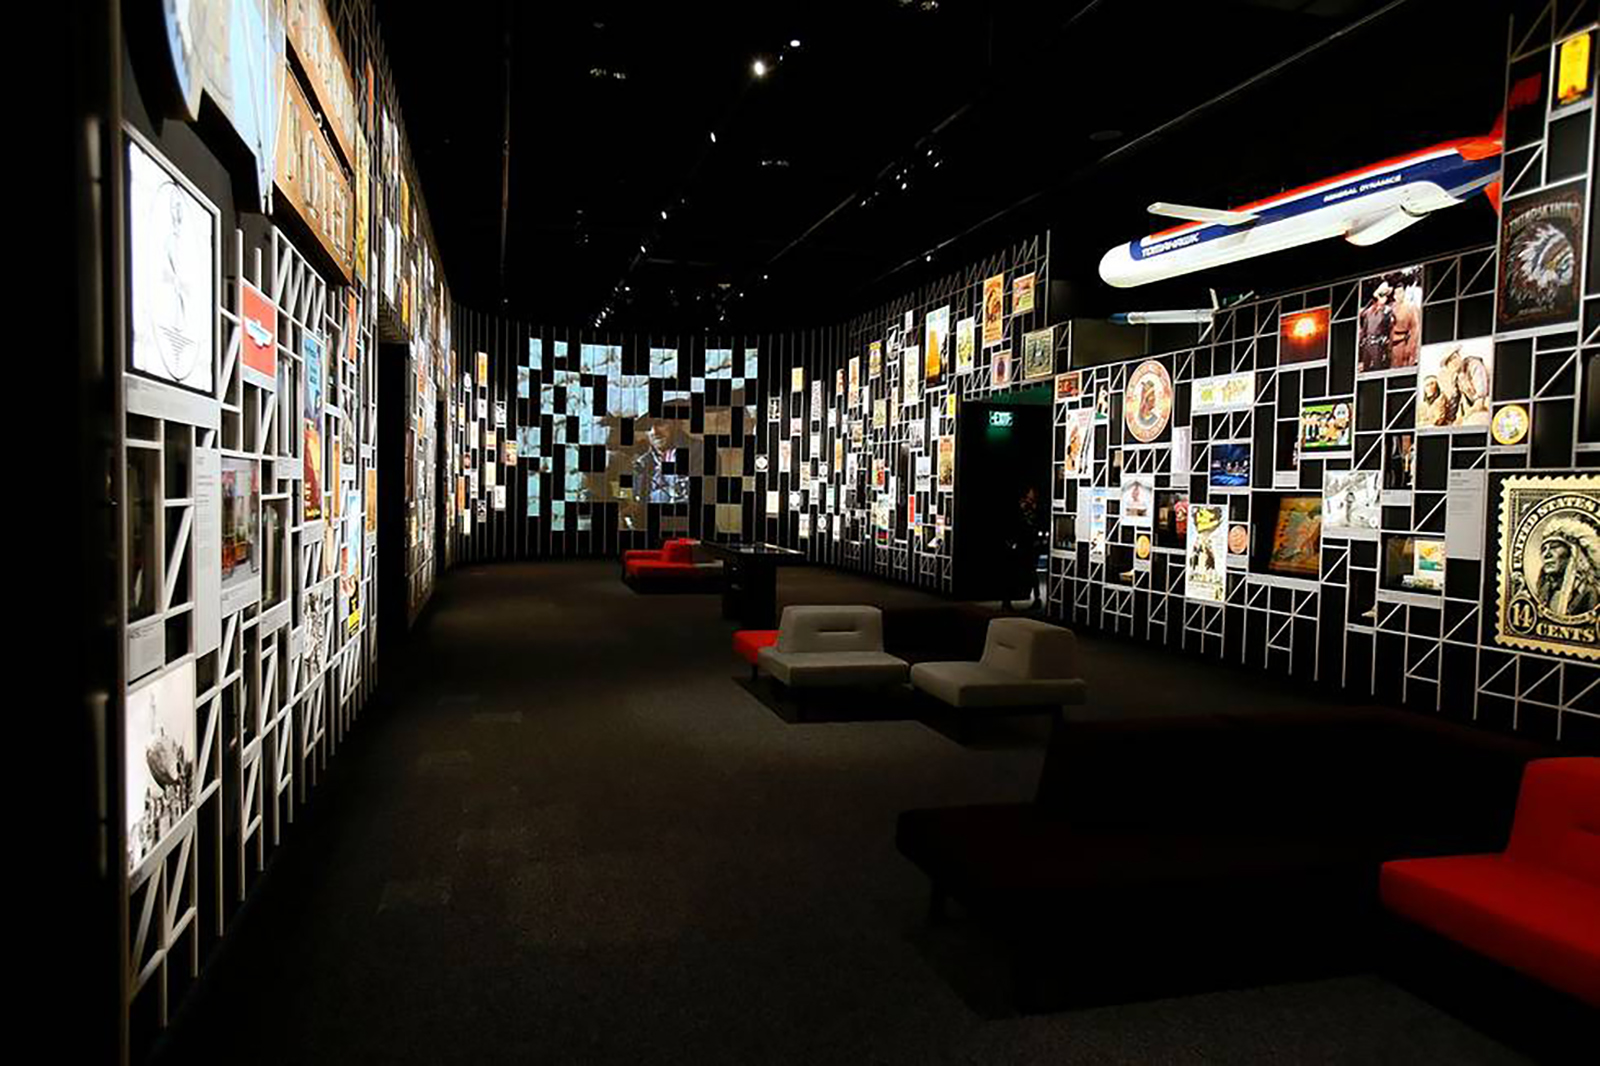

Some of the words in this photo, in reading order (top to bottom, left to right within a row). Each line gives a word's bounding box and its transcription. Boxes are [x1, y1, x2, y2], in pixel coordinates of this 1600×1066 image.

[1513, 511, 1540, 568] UNITED
[1537, 496, 1595, 517] STATES
[1511, 602, 1533, 628] 14
[1536, 622, 1595, 643] CENTS
